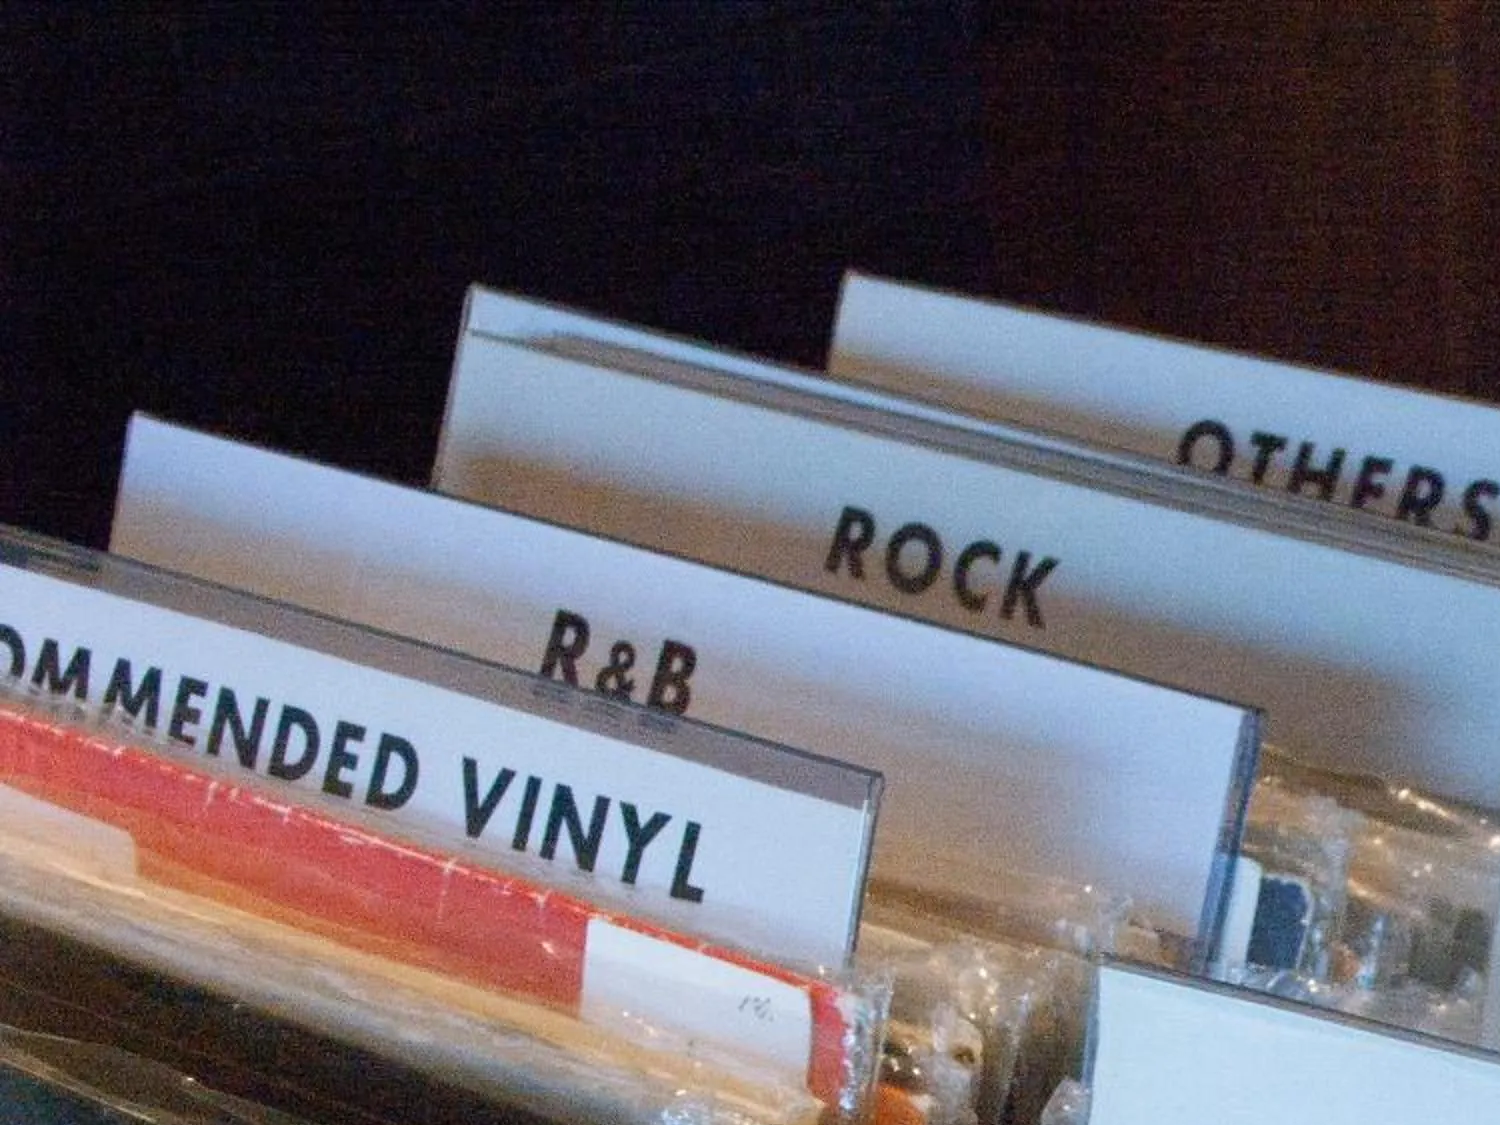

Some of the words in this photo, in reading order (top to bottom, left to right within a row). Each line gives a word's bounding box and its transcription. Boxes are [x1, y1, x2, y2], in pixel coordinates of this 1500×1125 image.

[824, 505, 1061, 629] ROCK
[540, 609, 699, 717] R&B
[461, 756, 706, 903] VINYL
